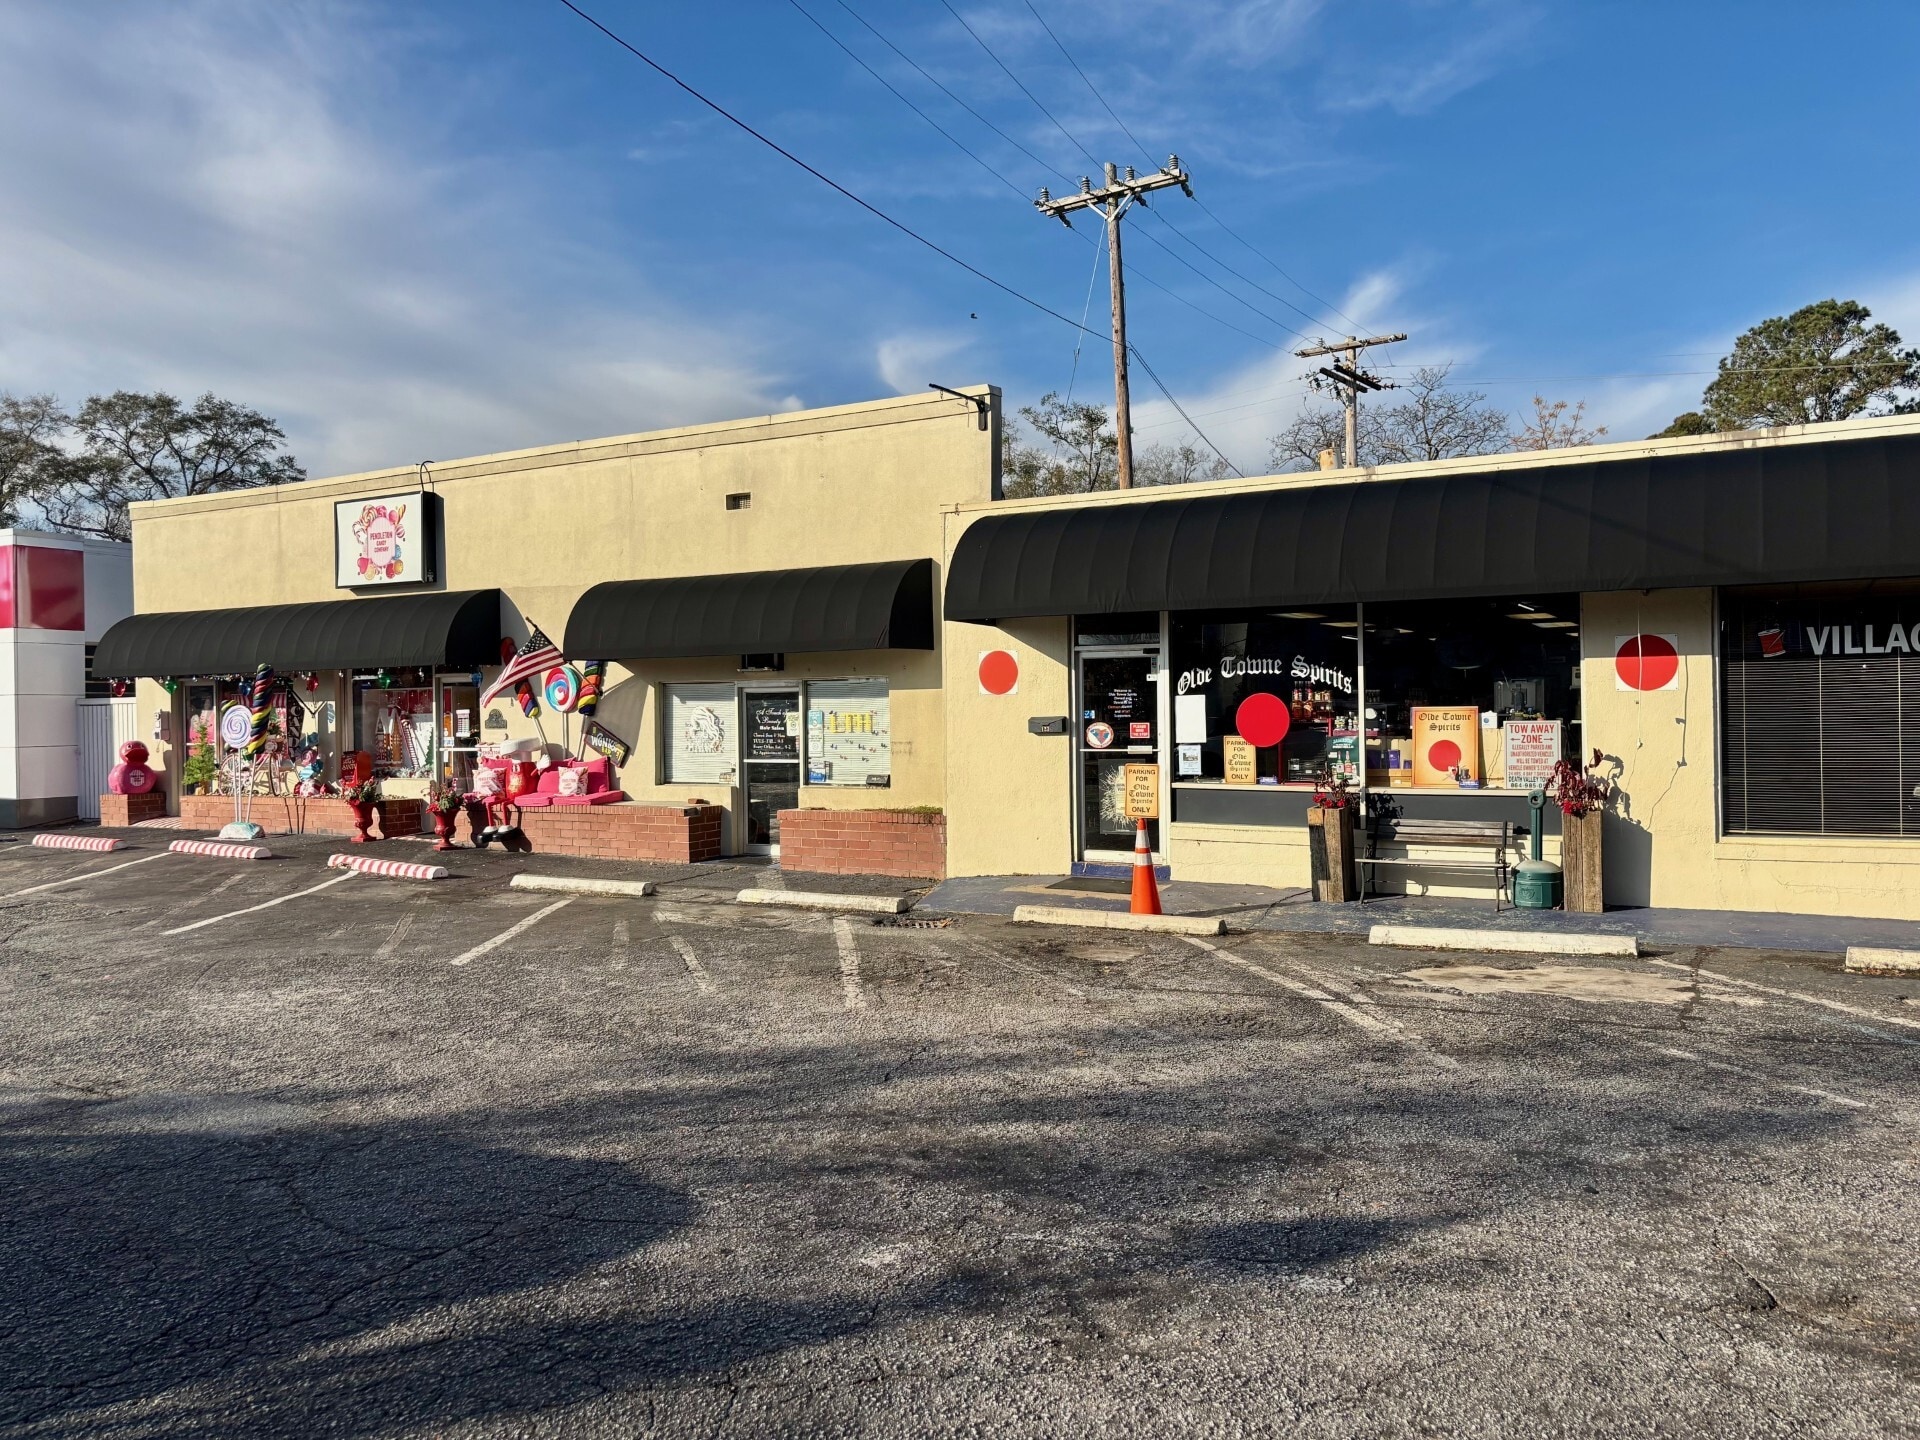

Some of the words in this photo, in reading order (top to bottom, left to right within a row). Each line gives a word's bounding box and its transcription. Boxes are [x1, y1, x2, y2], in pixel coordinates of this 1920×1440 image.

[370, 532, 392, 540] PENDLETON
[1178, 667, 1213, 695] Olde
[1220, 655, 1283, 678] Towne
[1290, 655, 1352, 694] Spirits
[1429, 723, 1461, 732] Spirits
[1509, 725, 1528, 733] TOW
[1531, 725, 1554, 733] AWAY
[1521, 735, 1543, 743] ZONE
